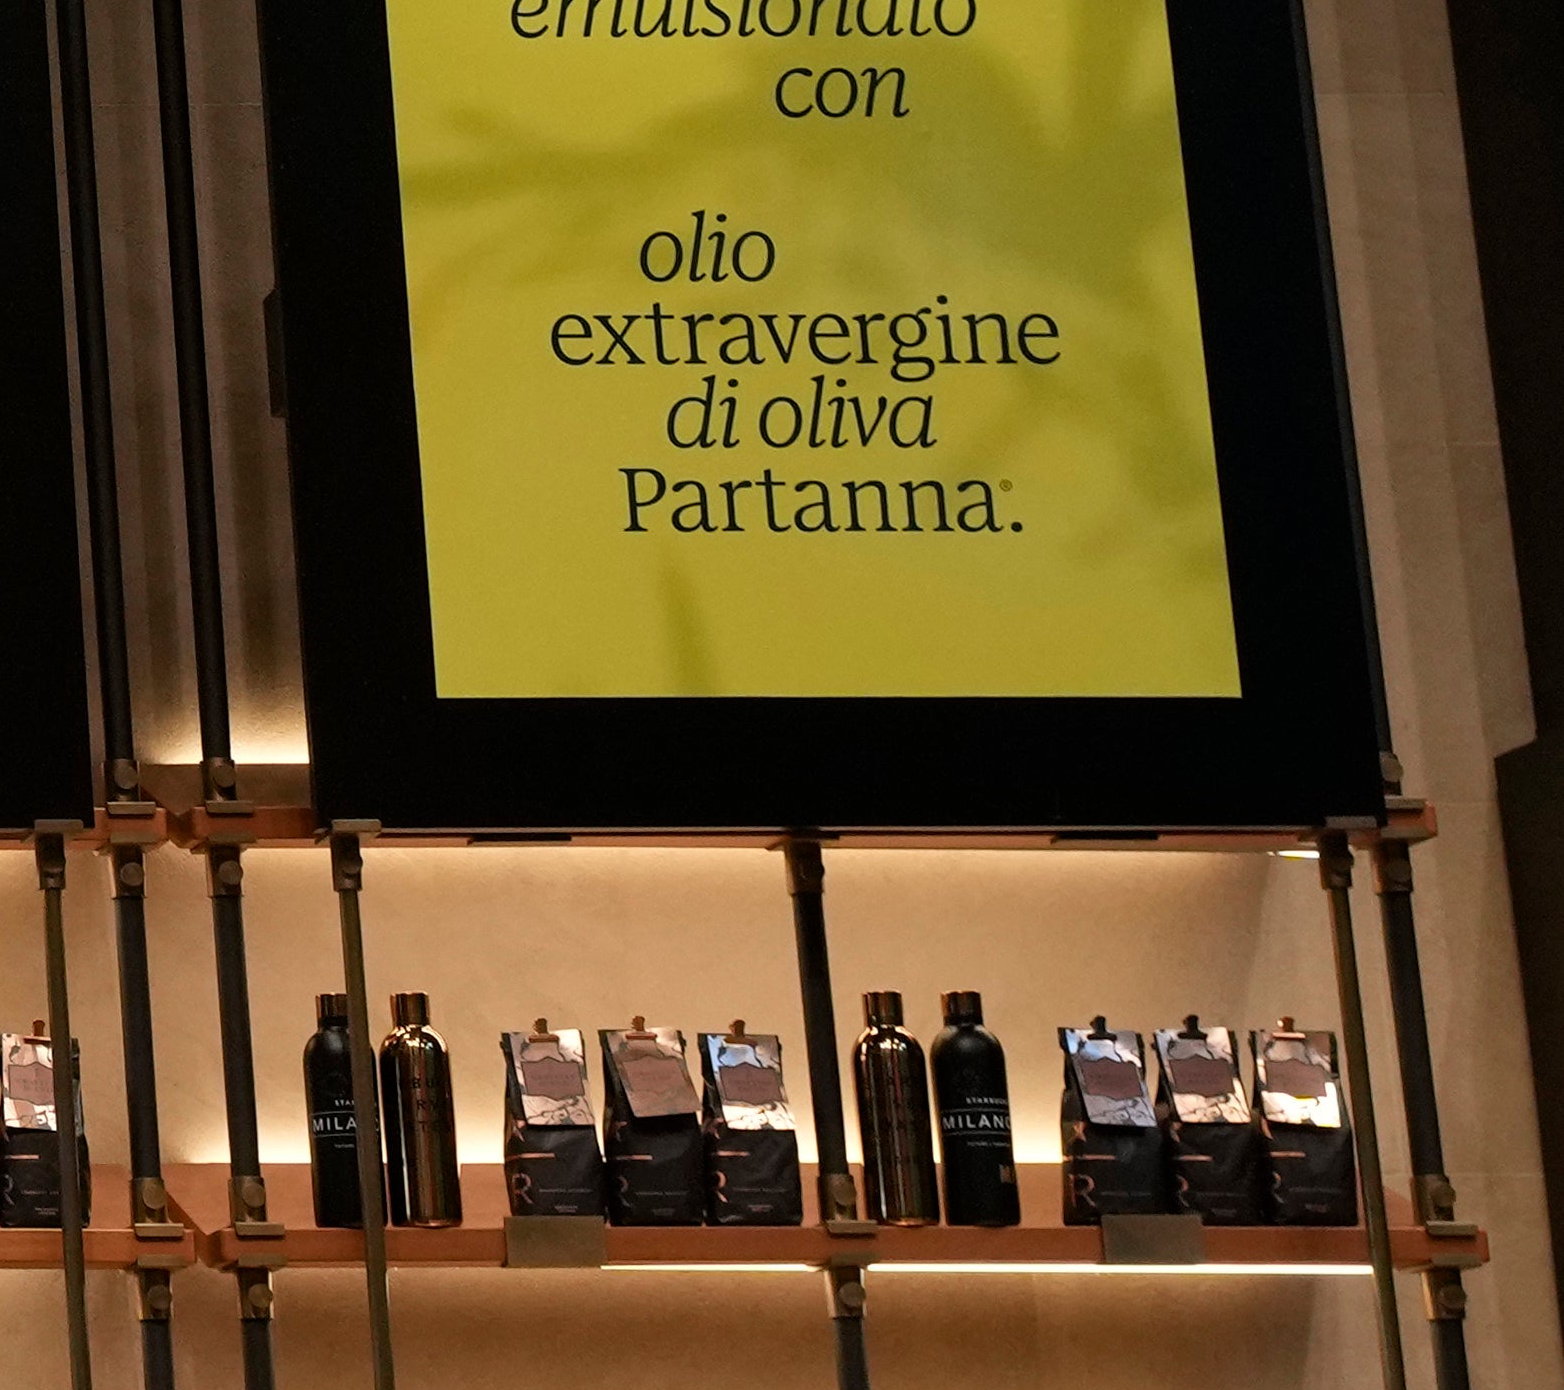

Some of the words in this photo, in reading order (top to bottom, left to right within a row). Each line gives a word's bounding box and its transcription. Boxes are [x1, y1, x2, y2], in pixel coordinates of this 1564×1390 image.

[774, 65, 910, 119] con
[639, 209, 775, 283] olio
[550, 294, 1062, 382] extravergine
[666, 375, 741, 449] di
[758, 375, 938, 449] oliva
[618, 467, 1024, 533] Partanna.
[312, 1115, 357, 1132] MILA
